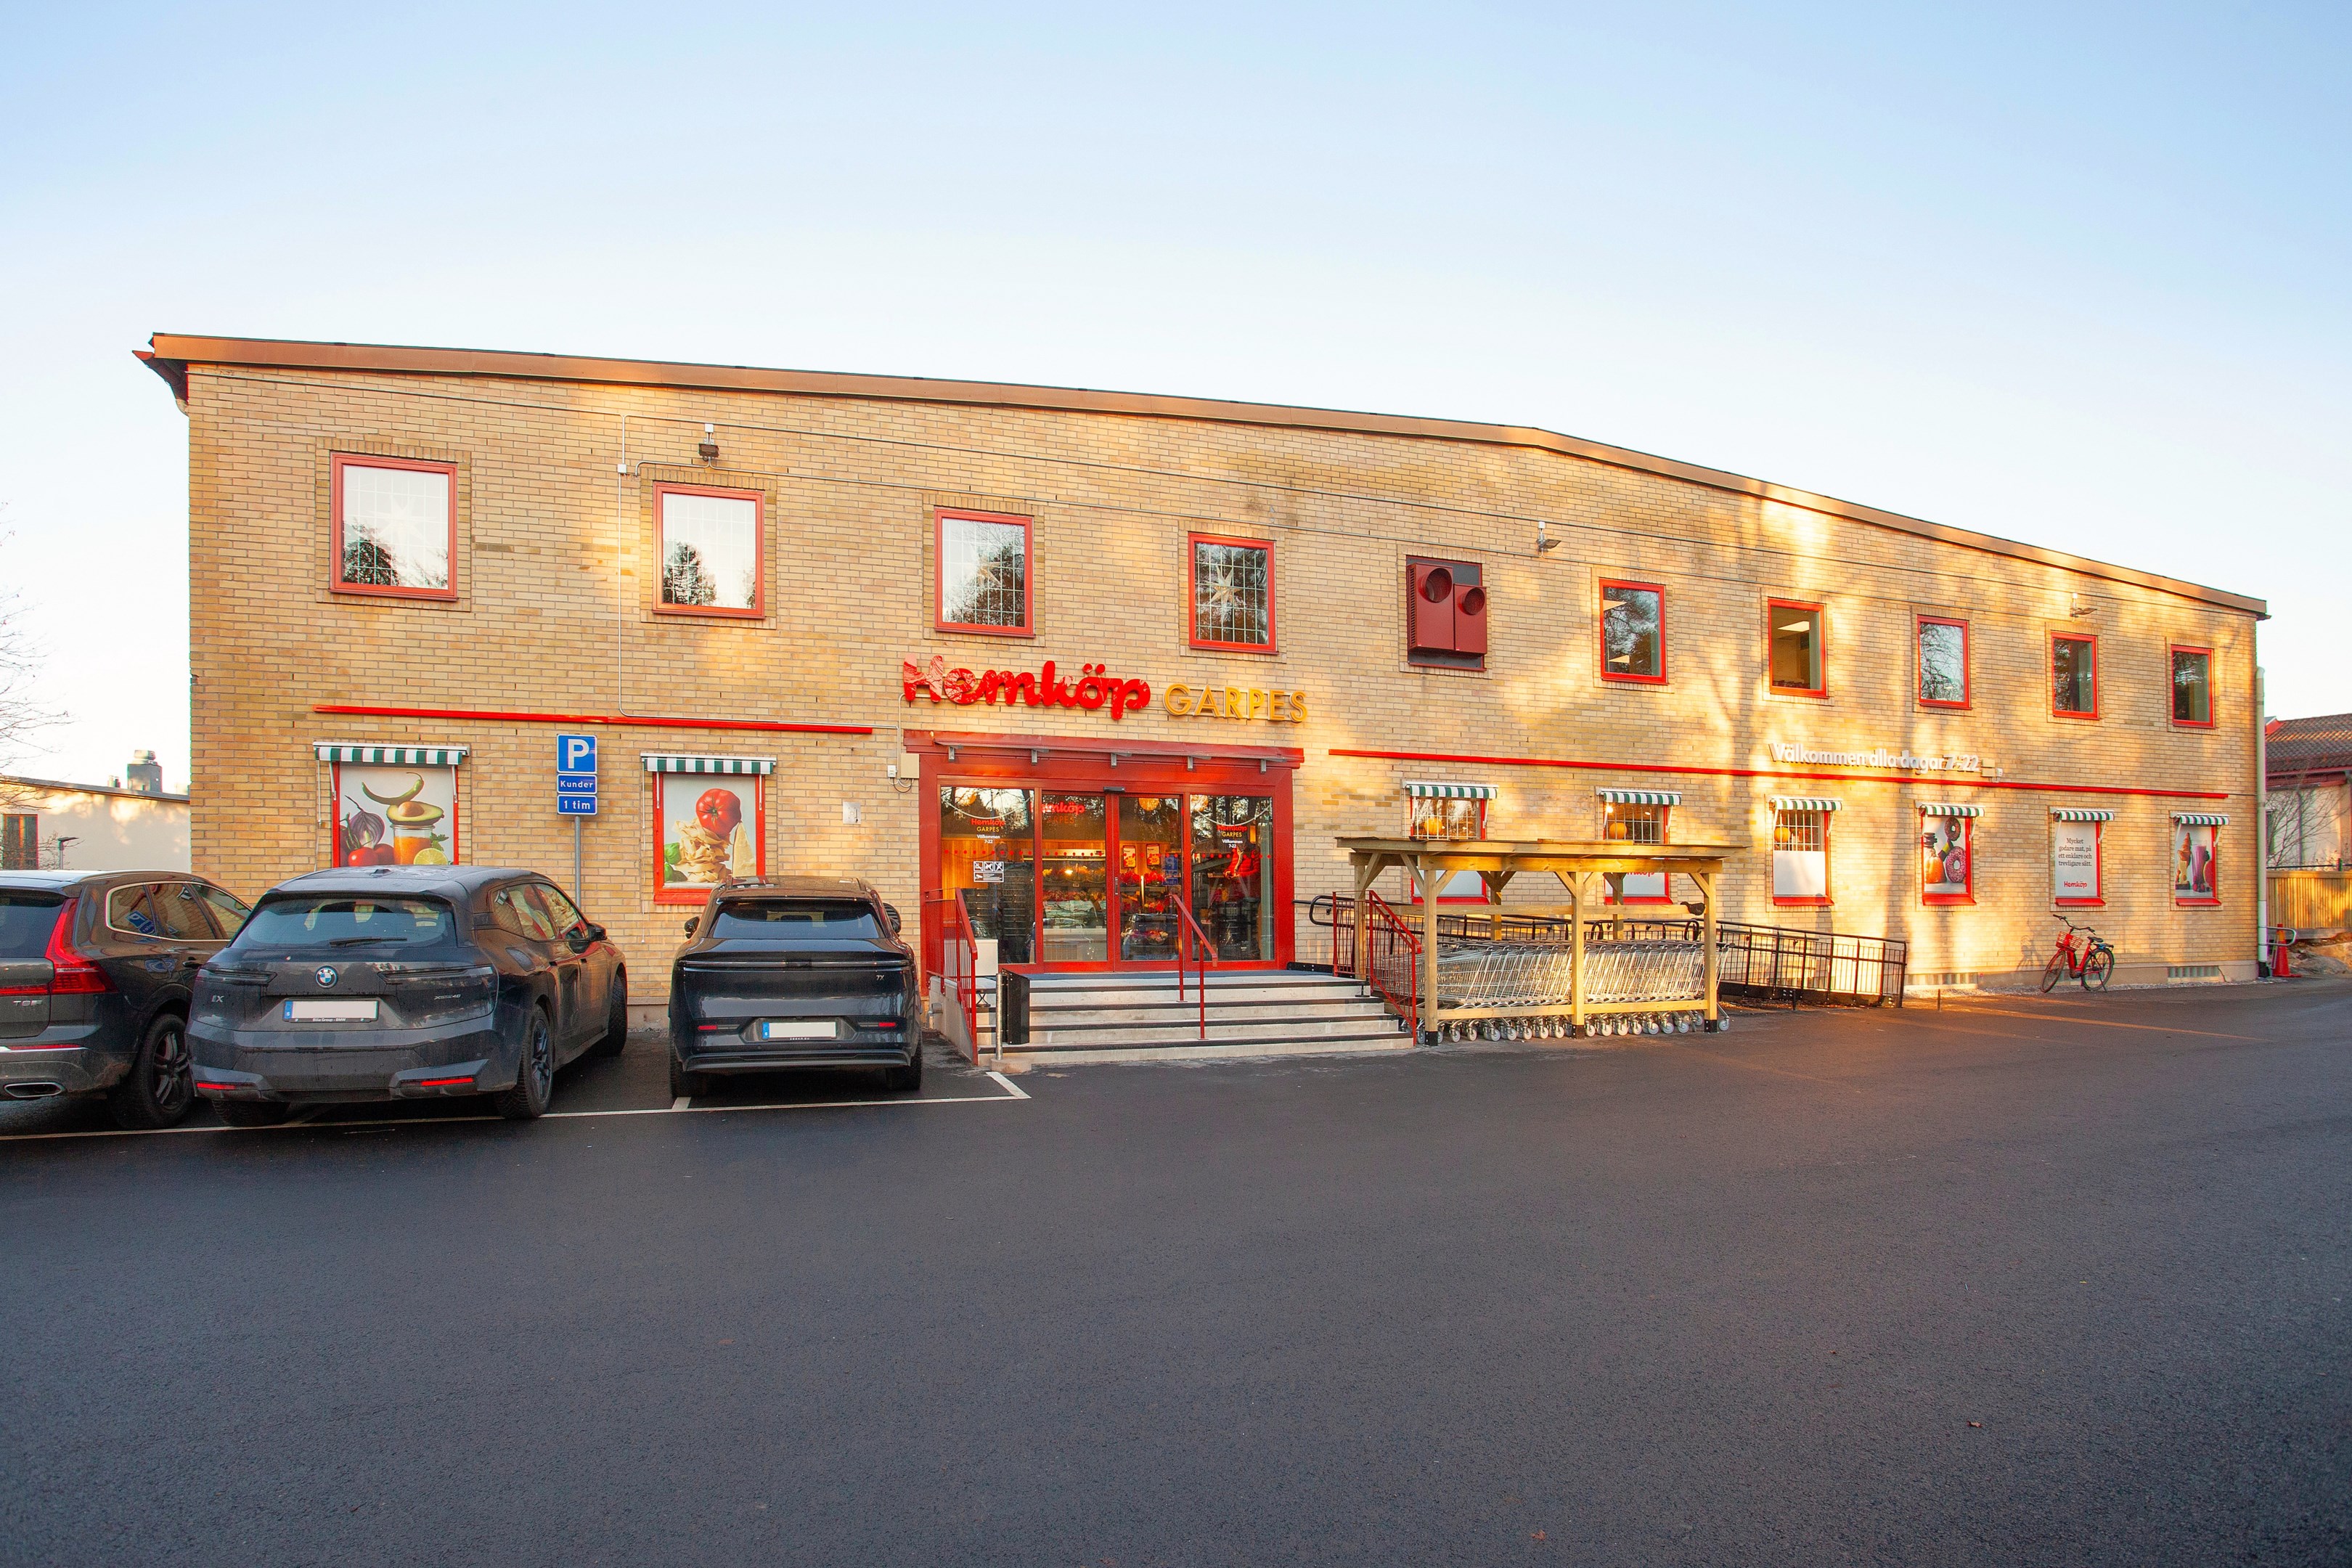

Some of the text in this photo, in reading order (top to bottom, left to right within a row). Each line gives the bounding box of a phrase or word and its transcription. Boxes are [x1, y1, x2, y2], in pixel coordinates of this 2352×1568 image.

[903, 653, 1307, 723] Hemköp GARPES
[568, 739, 589, 769] P
[1769, 743, 1866, 767] Välkommen
[1869, 748, 1897, 767] alla
[1898, 750, 1944, 775] dagar
[573, 800, 591, 809] tim
[971, 818, 1005, 827] Hemköp
